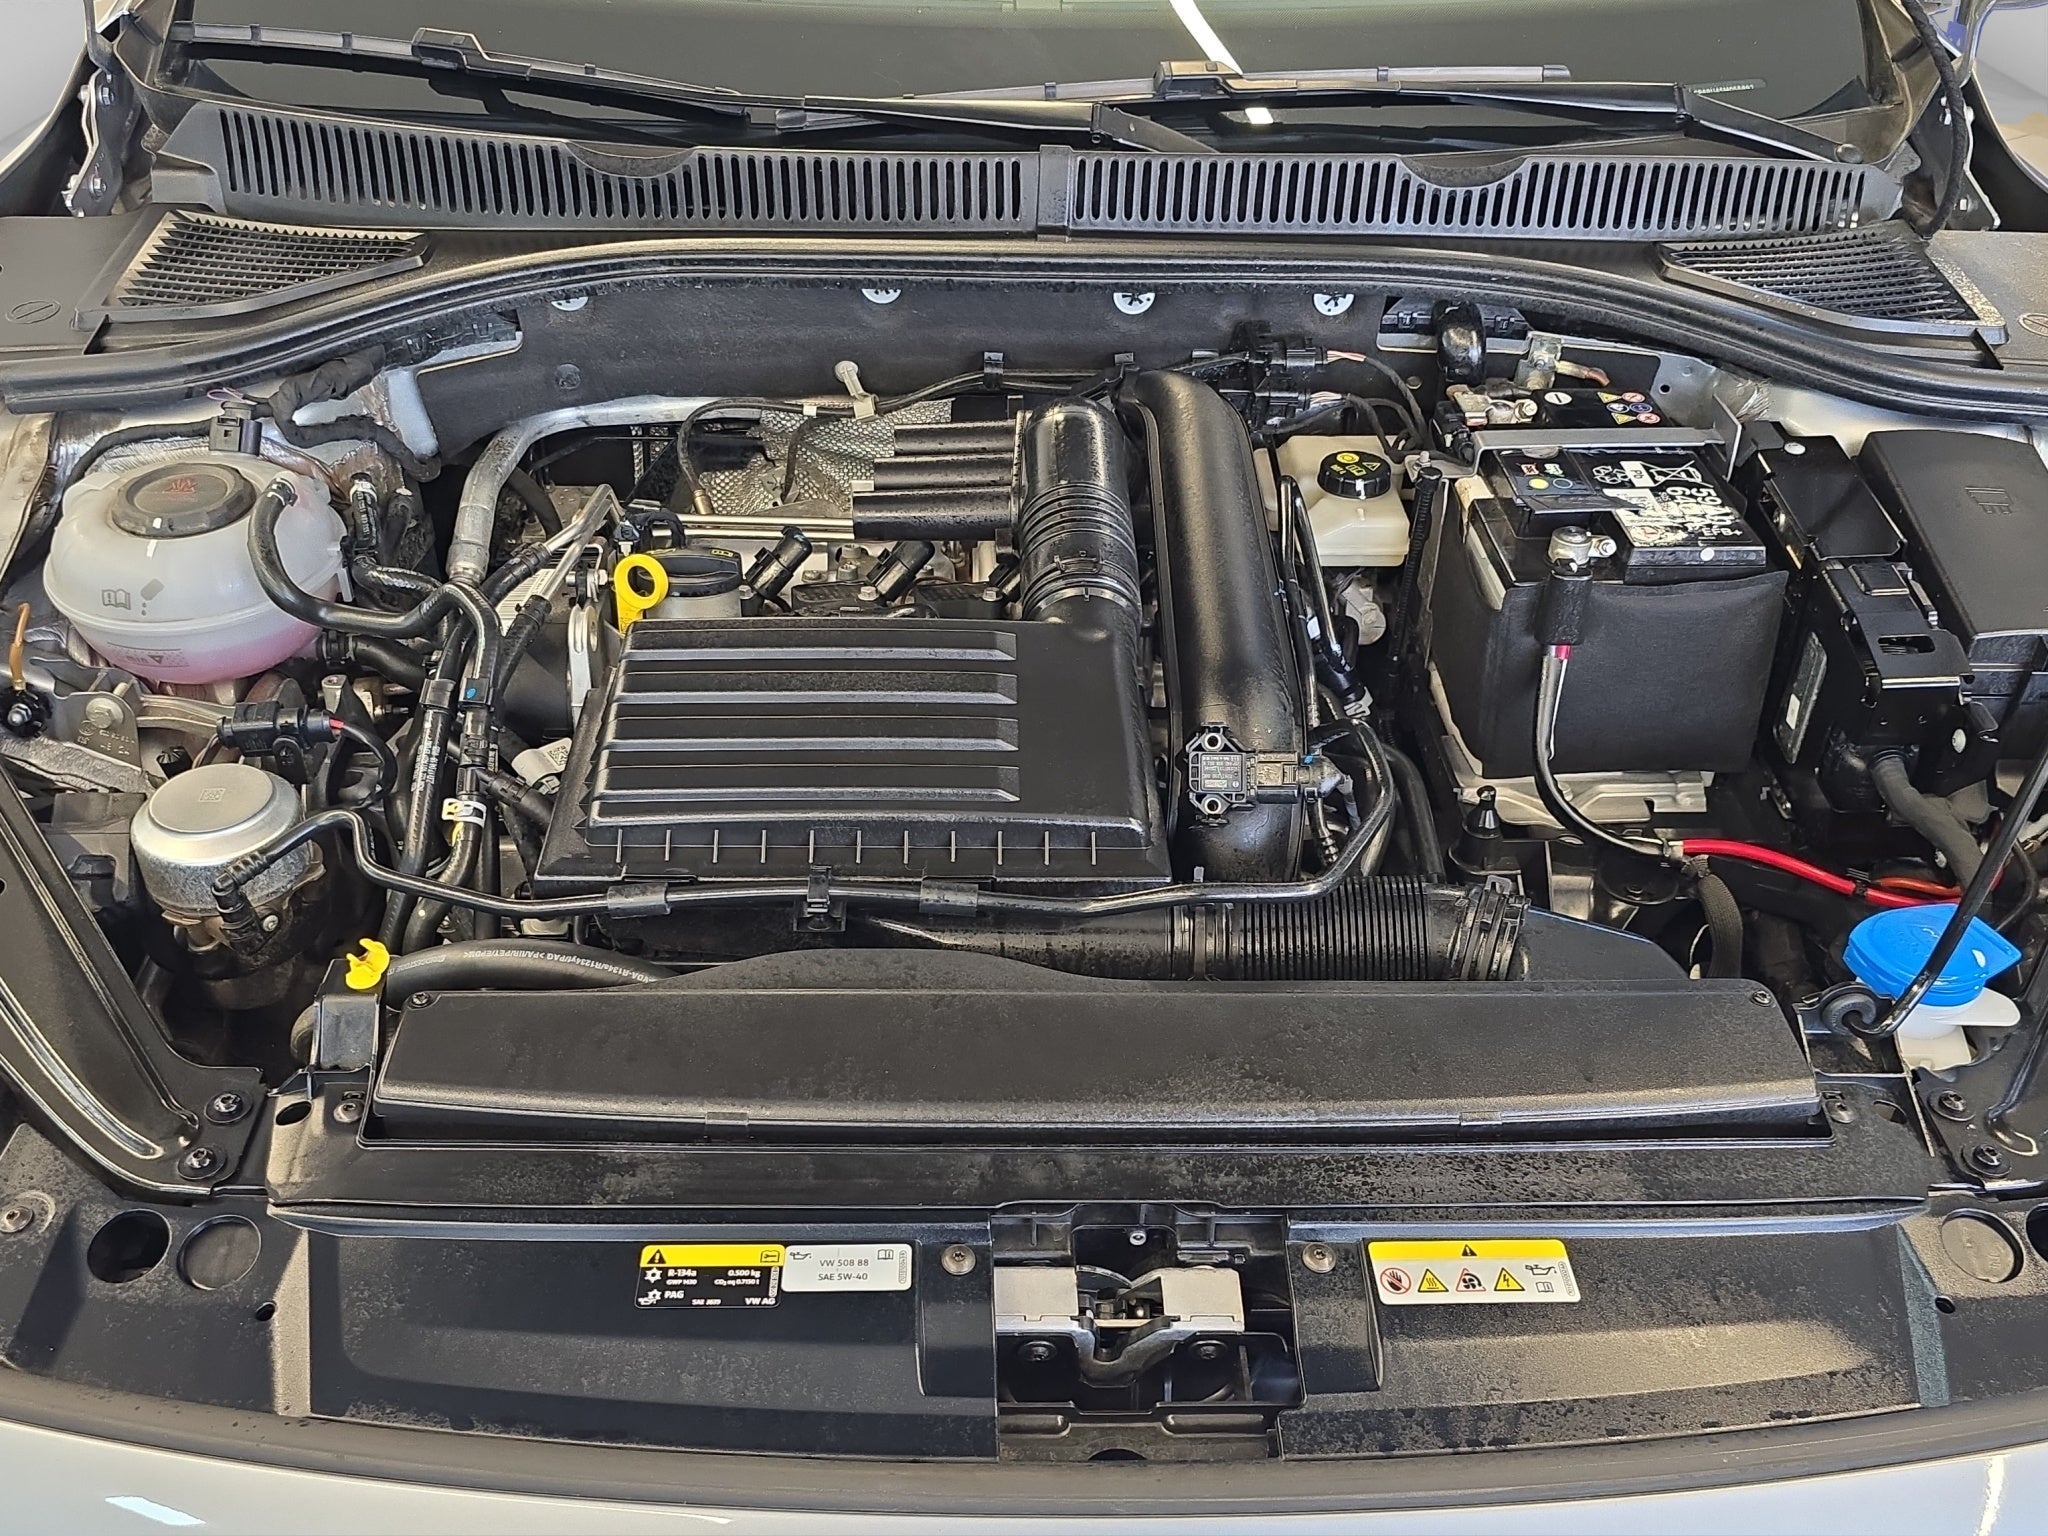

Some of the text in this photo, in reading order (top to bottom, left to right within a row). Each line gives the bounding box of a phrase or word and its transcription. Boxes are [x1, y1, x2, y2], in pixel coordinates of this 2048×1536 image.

[1702, 526, 1743, 537] EFB+
[819, 1259, 869, 1267] VW 508 88
[667, 1268, 761, 1278] R-134a 0.500 kg
[818, 1273, 868, 1281] SAE 5W-40
[664, 1290, 684, 1299] PAG
[745, 1297, 761, 1305] VW
